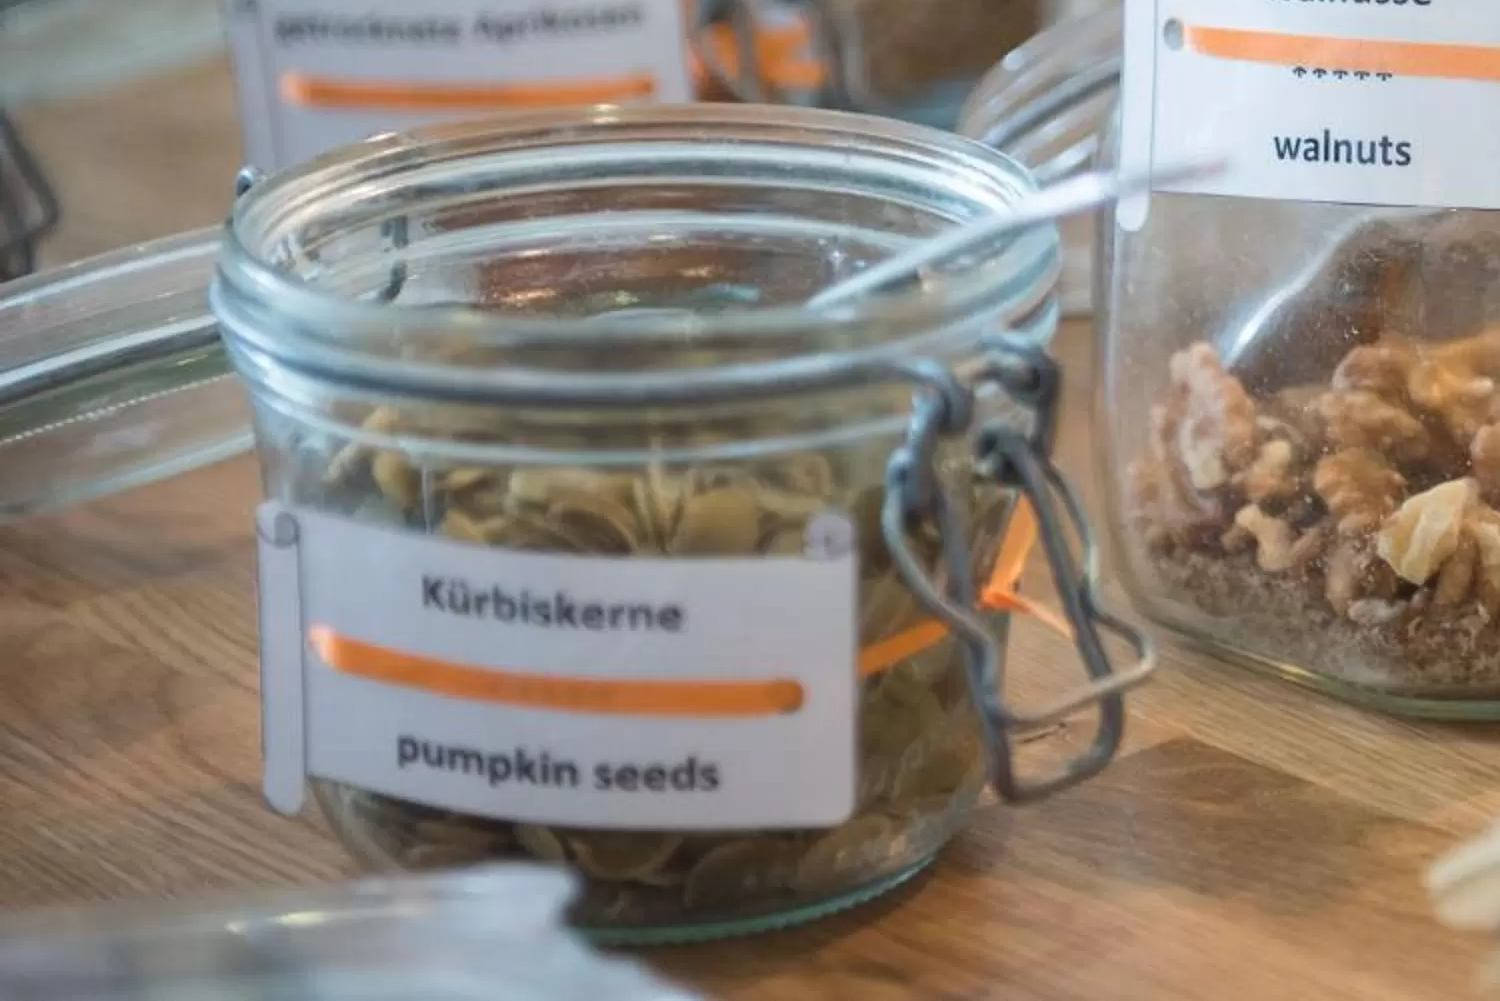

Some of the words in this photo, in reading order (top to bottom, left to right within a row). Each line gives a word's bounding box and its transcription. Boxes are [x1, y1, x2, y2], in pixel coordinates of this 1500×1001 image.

[1273, 129, 1412, 166] walnuts
[422, 575, 684, 631] Kürbiskerne
[396, 734, 579, 788] pumpkin
[593, 754, 720, 792] seeds
